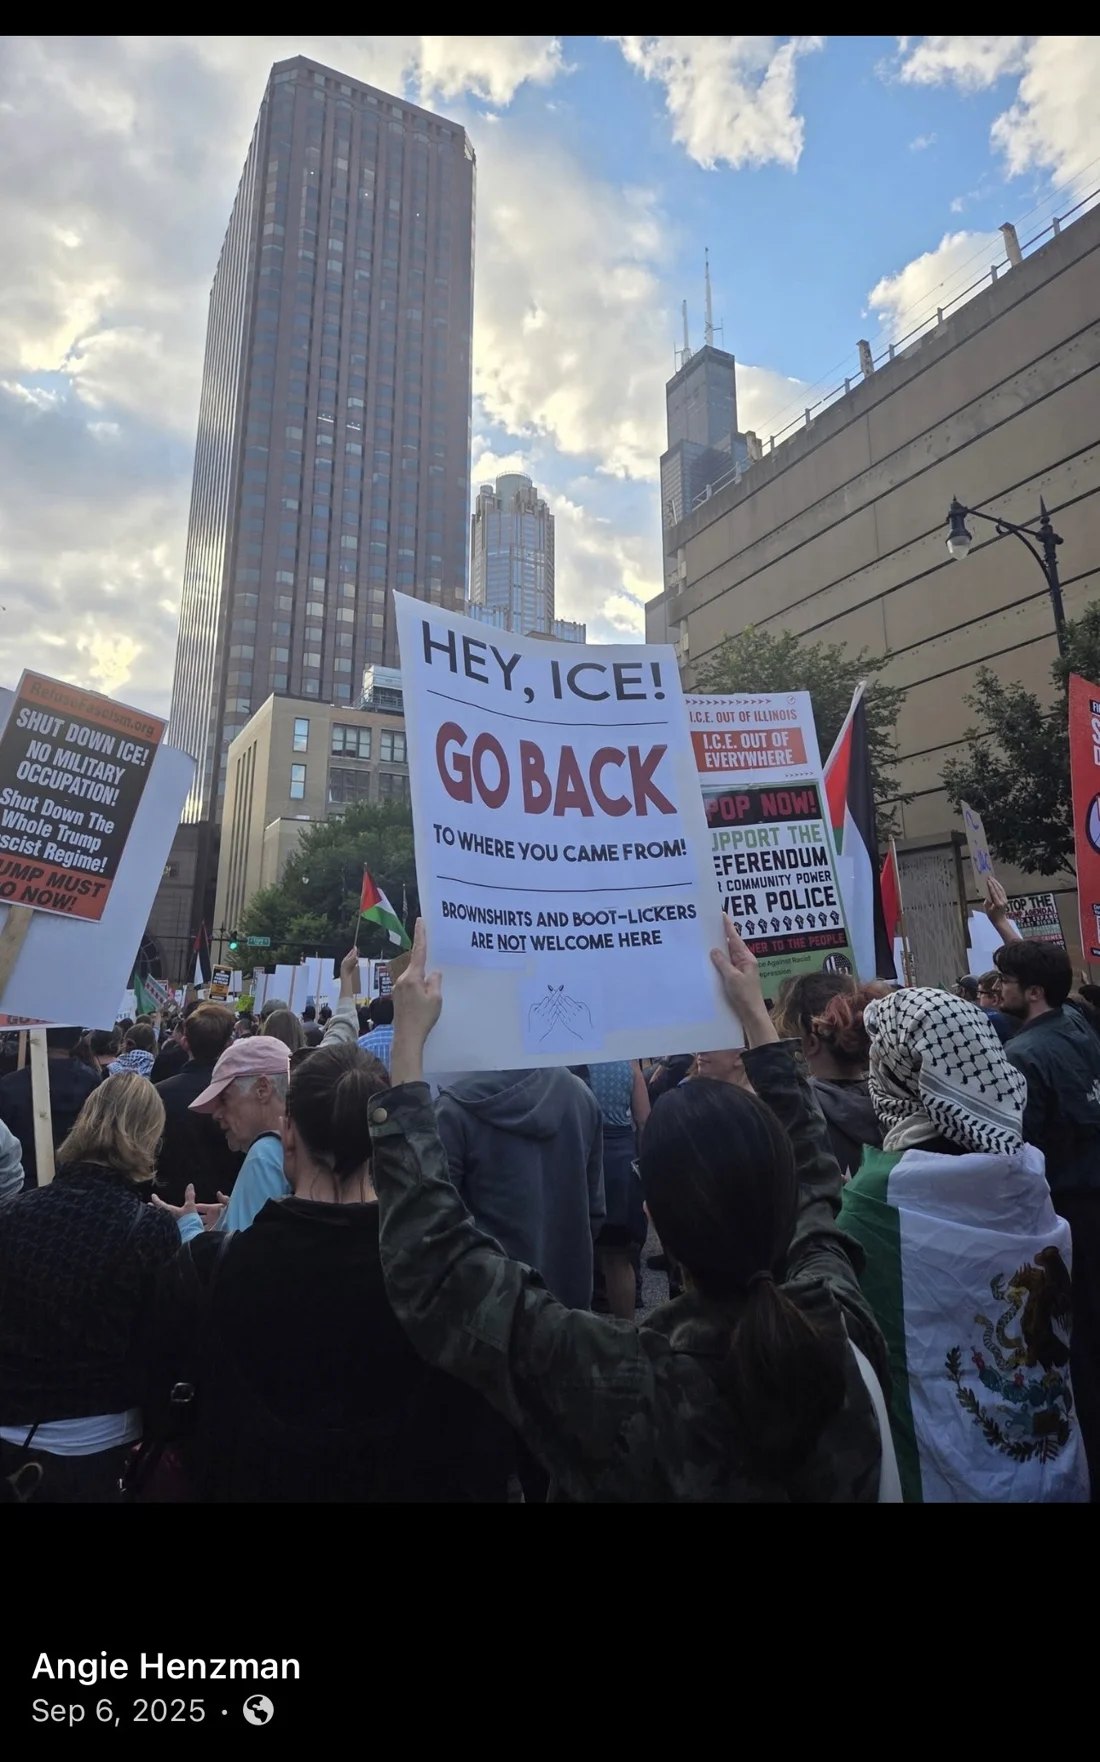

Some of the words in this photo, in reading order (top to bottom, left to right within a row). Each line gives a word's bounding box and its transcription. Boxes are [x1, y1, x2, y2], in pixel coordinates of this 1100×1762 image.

[421, 620, 535, 704] HEY,
[550, 660, 665, 701] ICE!
[30, 682, 156, 737] RefuseFascism.org
[716, 711, 735, 723] OUT
[738, 711, 751, 722] OF
[753, 709, 798, 722] ILLINOIS
[16, 708, 65, 737] SHUT
[65, 723, 116, 755] DOWN
[116, 740, 150, 767] ICE!
[702, 733, 738, 750] I.C.E.
[741, 732, 767, 749] OUT
[771, 731, 789, 747] OF
[26, 739, 52, 763] NO
[52, 747, 126, 786] MILITARY
[435, 721, 510, 810] GO
[519, 739, 678, 818] BACK
[704, 748, 795, 769] EVERYWHERE
[16, 760, 120, 807] OCCUPATION!
[0, 787, 40, 813] Shut
[40, 798, 85, 826] Down
[88, 811, 116, 835] The
[759, 790, 817, 817] NOW!
[1, 808, 53, 838] Whole
[56, 823, 103, 854] Trump
[433, 823, 456, 846] TO
[457, 829, 516, 859] WHERE
[517, 841, 558, 862] YOU
[563, 844, 620, 863] CAME
[623, 838, 687, 861] FROM!
[786, 823, 823, 845] THE
[42, 841, 109, 874] Regime!
[45, 871, 106, 898] MUST
[726, 874, 792, 892] COMMUNITY
[796, 870, 832, 885] POWER
[20, 885, 78, 912] NOW!
[765, 885, 837, 913] POLICE
[1028, 894, 1053, 909] THE
[441, 900, 533, 928] BROWNSHIRTS
[536, 912, 569, 928] AND
[573, 904, 698, 928] BOOT-LICKERS
[471, 931, 494, 949] ARE
[498, 934, 527, 951] NOT
[529, 934, 614, 951] WELCOME
[618, 930, 663, 948] HERE
[771, 939, 785, 951] TO
[788, 936, 807, 949] THE
[808, 931, 846, 947] PEOPLE
